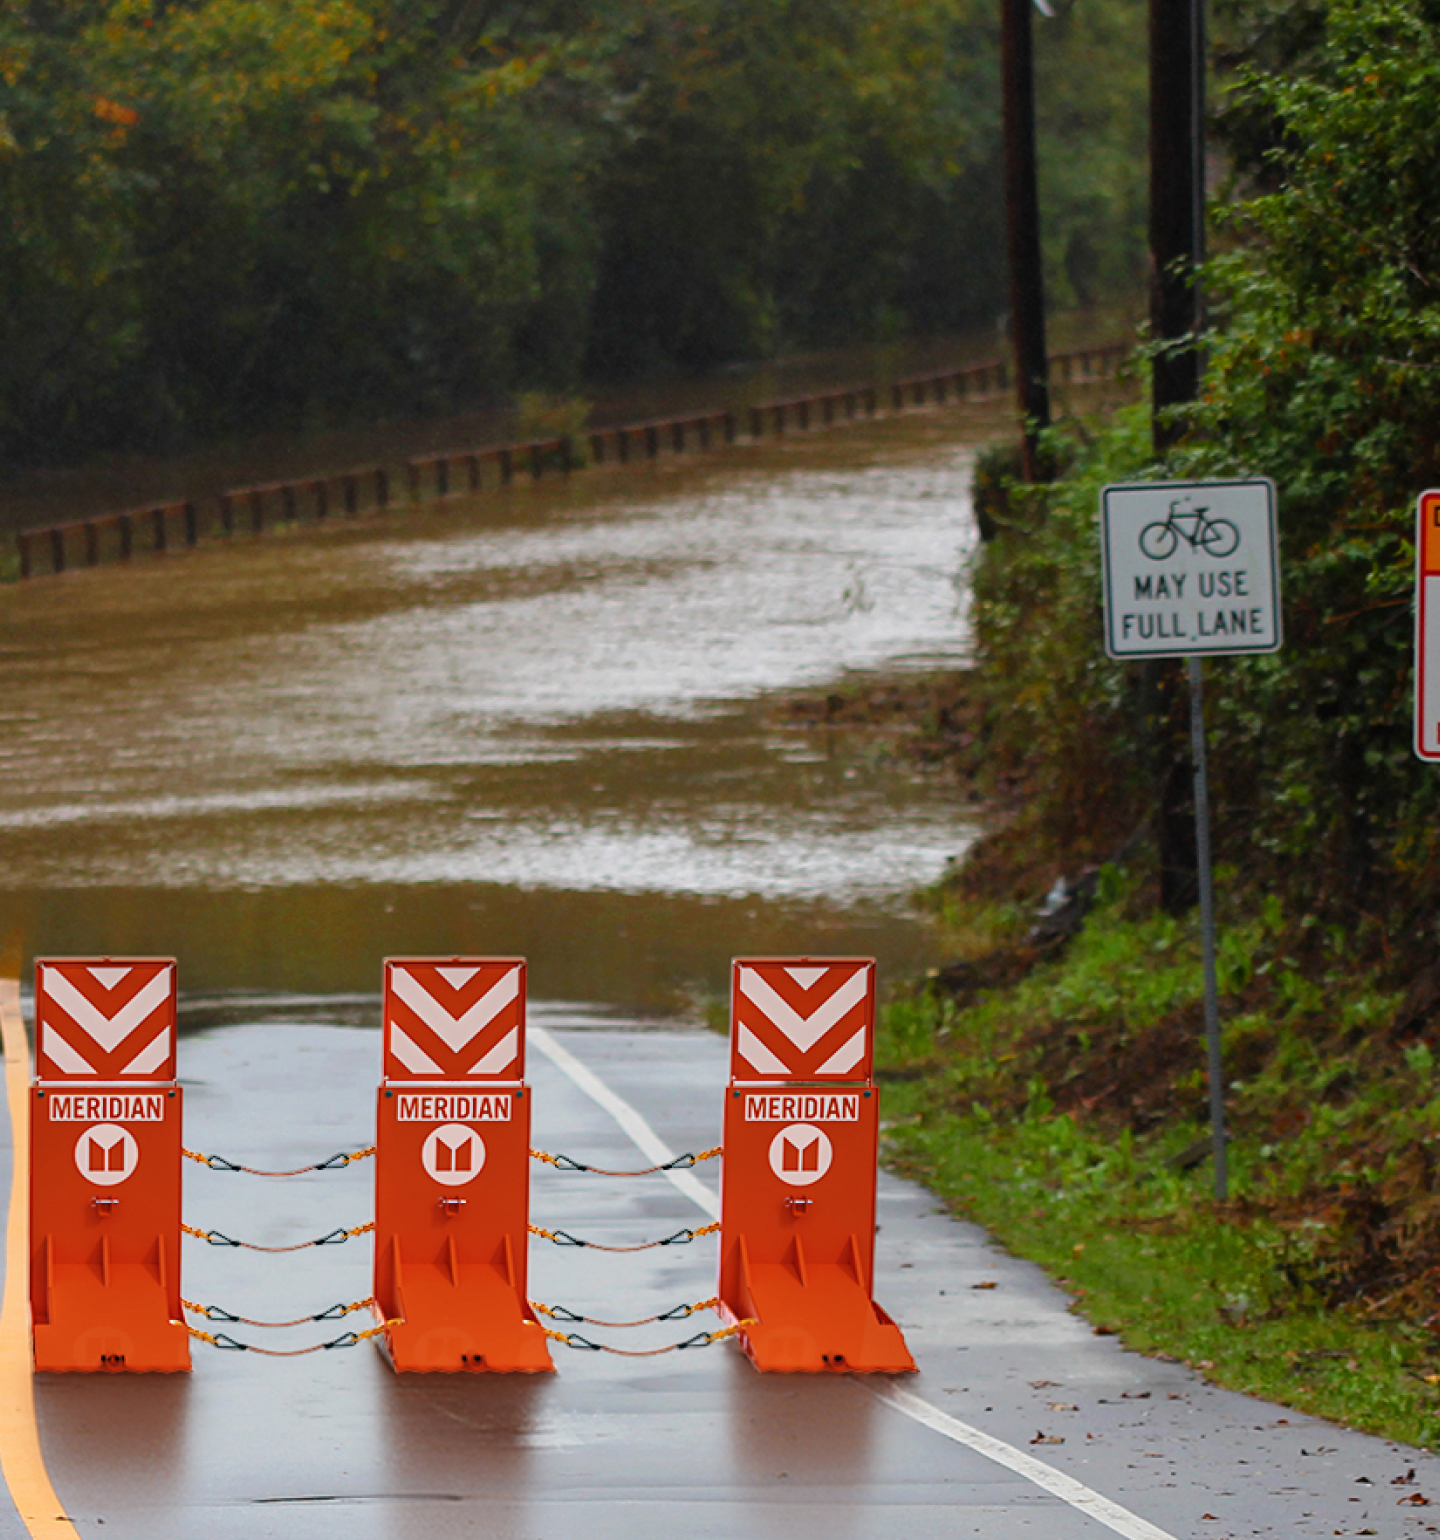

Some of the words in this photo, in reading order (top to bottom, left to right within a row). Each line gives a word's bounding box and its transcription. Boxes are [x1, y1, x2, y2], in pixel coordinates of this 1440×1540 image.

[1135, 573, 1187, 600] MAY
[1199, 570, 1250, 598] USE
[1122, 613, 1187, 640] FULL
[1198, 608, 1264, 636] LANE
[51, 1097, 162, 1119] MERIDIAN
[399, 1097, 509, 1119] MERIDIAN
[747, 1097, 856, 1119] MERIDIAN
